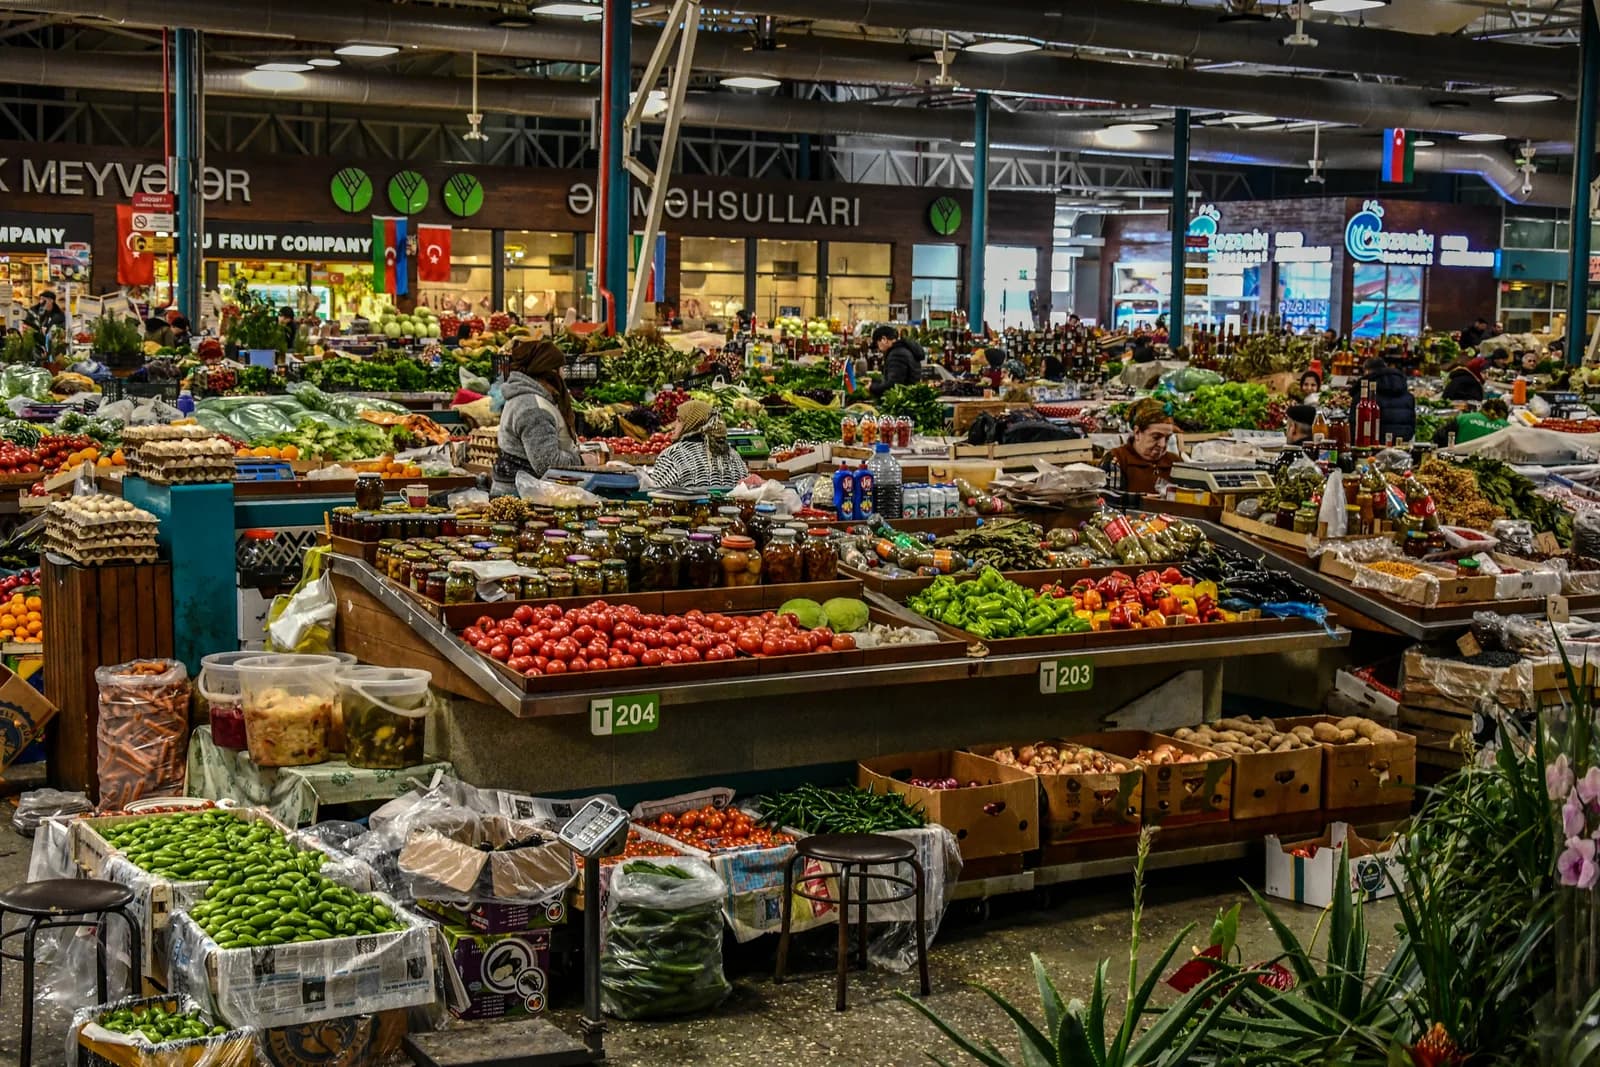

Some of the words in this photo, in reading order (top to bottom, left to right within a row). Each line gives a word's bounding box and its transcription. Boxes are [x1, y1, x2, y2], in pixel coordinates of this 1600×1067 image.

[218, 233, 277, 252] FRUIT
[282, 235, 372, 254] COMPANY
[1043, 667, 1055, 687] T
[1058, 664, 1091, 686] 203
[594, 706, 610, 728] T
[615, 702, 656, 727] 204
